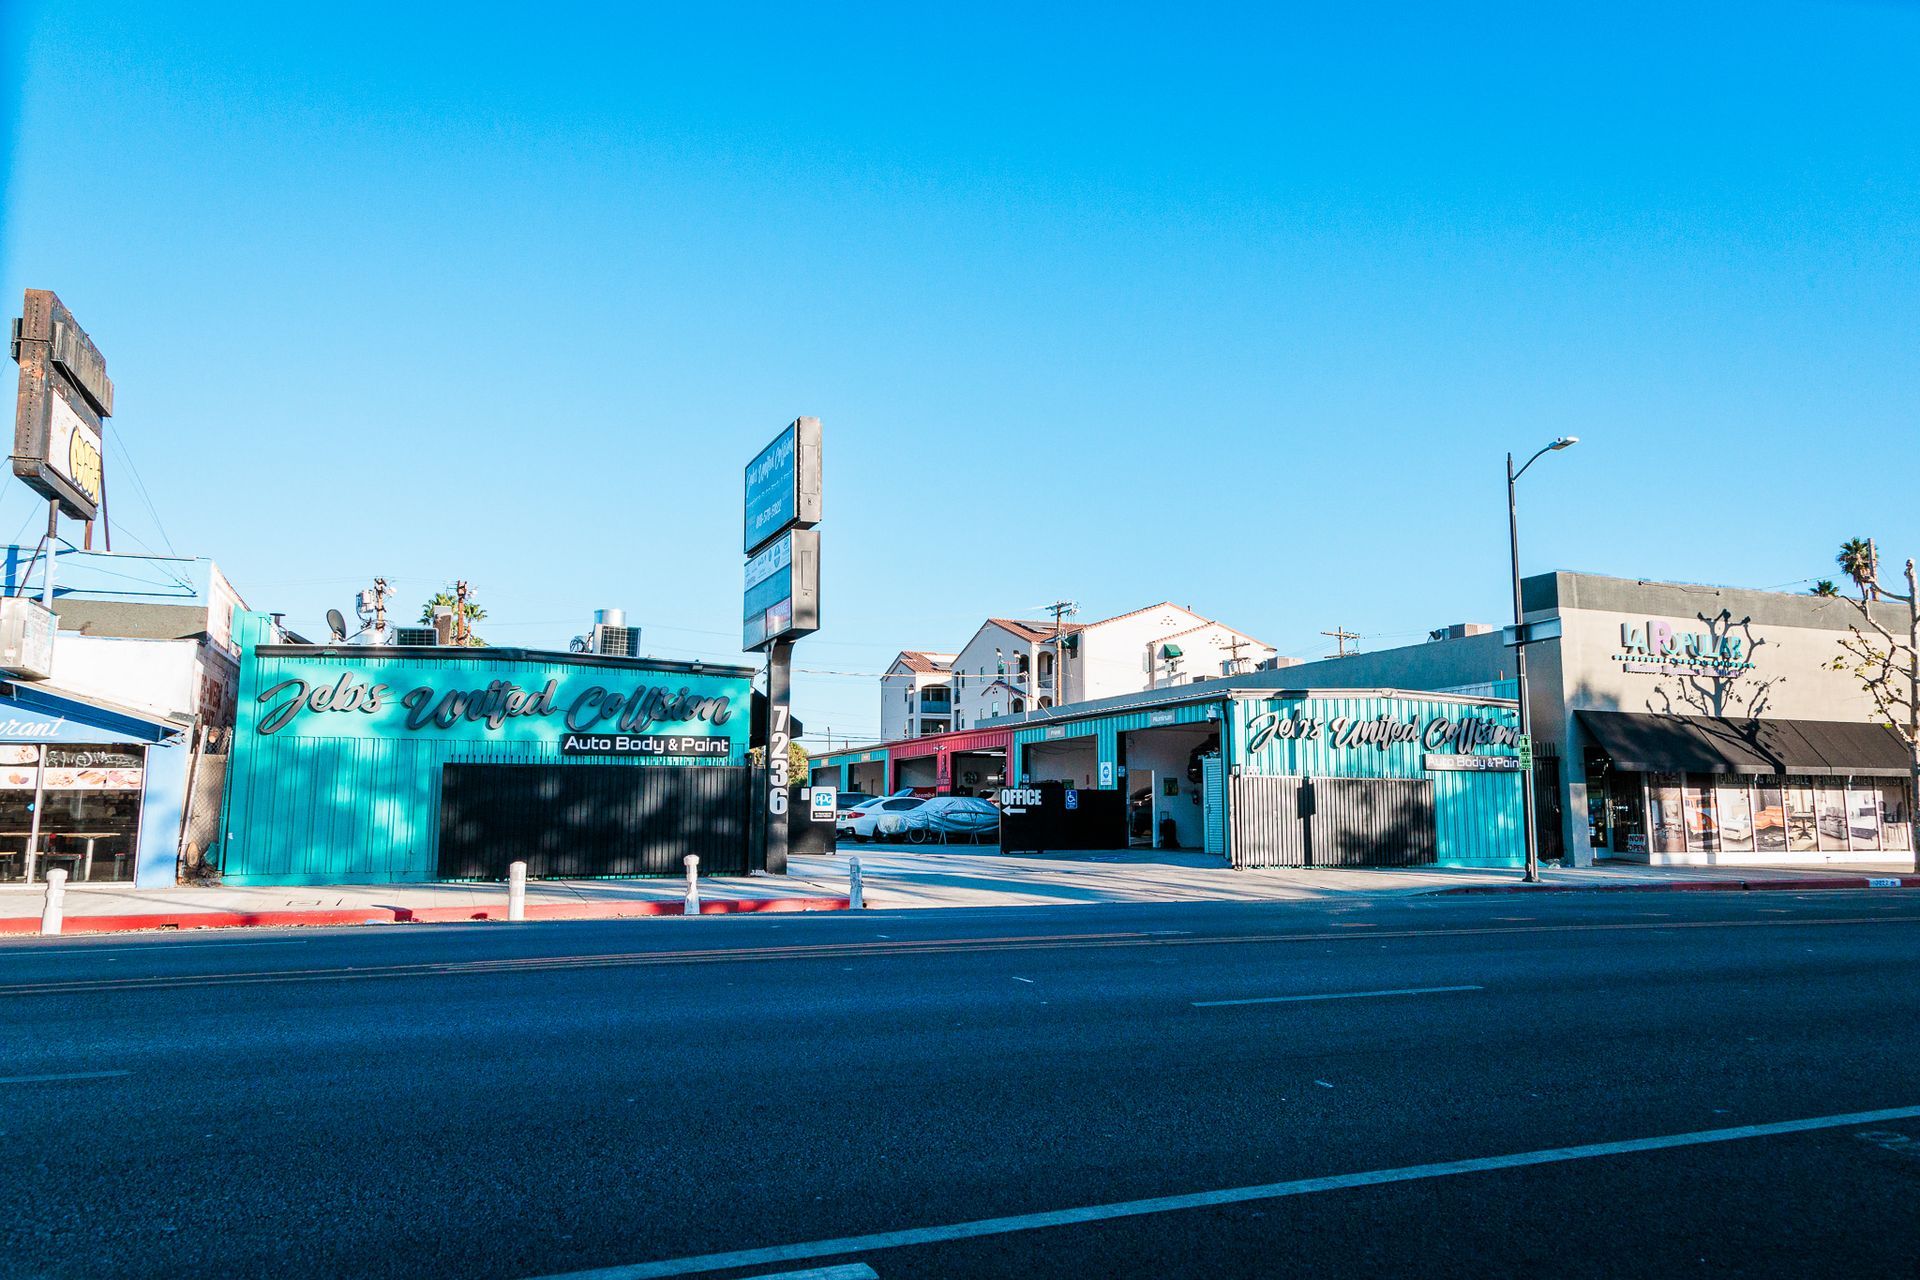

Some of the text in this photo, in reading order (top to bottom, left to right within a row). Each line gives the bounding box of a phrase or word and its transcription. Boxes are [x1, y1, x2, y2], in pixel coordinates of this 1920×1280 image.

[1622, 622, 1649, 653] LA
[401, 679, 557, 730] United
[565, 685, 732, 733] Collision
[0, 715, 64, 737] rant
[1331, 714, 1421, 750] United
[1422, 717, 1520, 755] Collision
[564, 736, 730, 754] Auto Body & Paint
[769, 705, 788, 815] 7236
[1427, 756, 1454, 767] Auto
[1457, 756, 1486, 770] Body
[1487, 759, 1495, 768] &
[1494, 758, 1520, 768] Pain
[1719, 772, 1763, 785] FINANG
[815, 793, 833, 806] PPG
[1001, 789, 1042, 806] OFFICE
